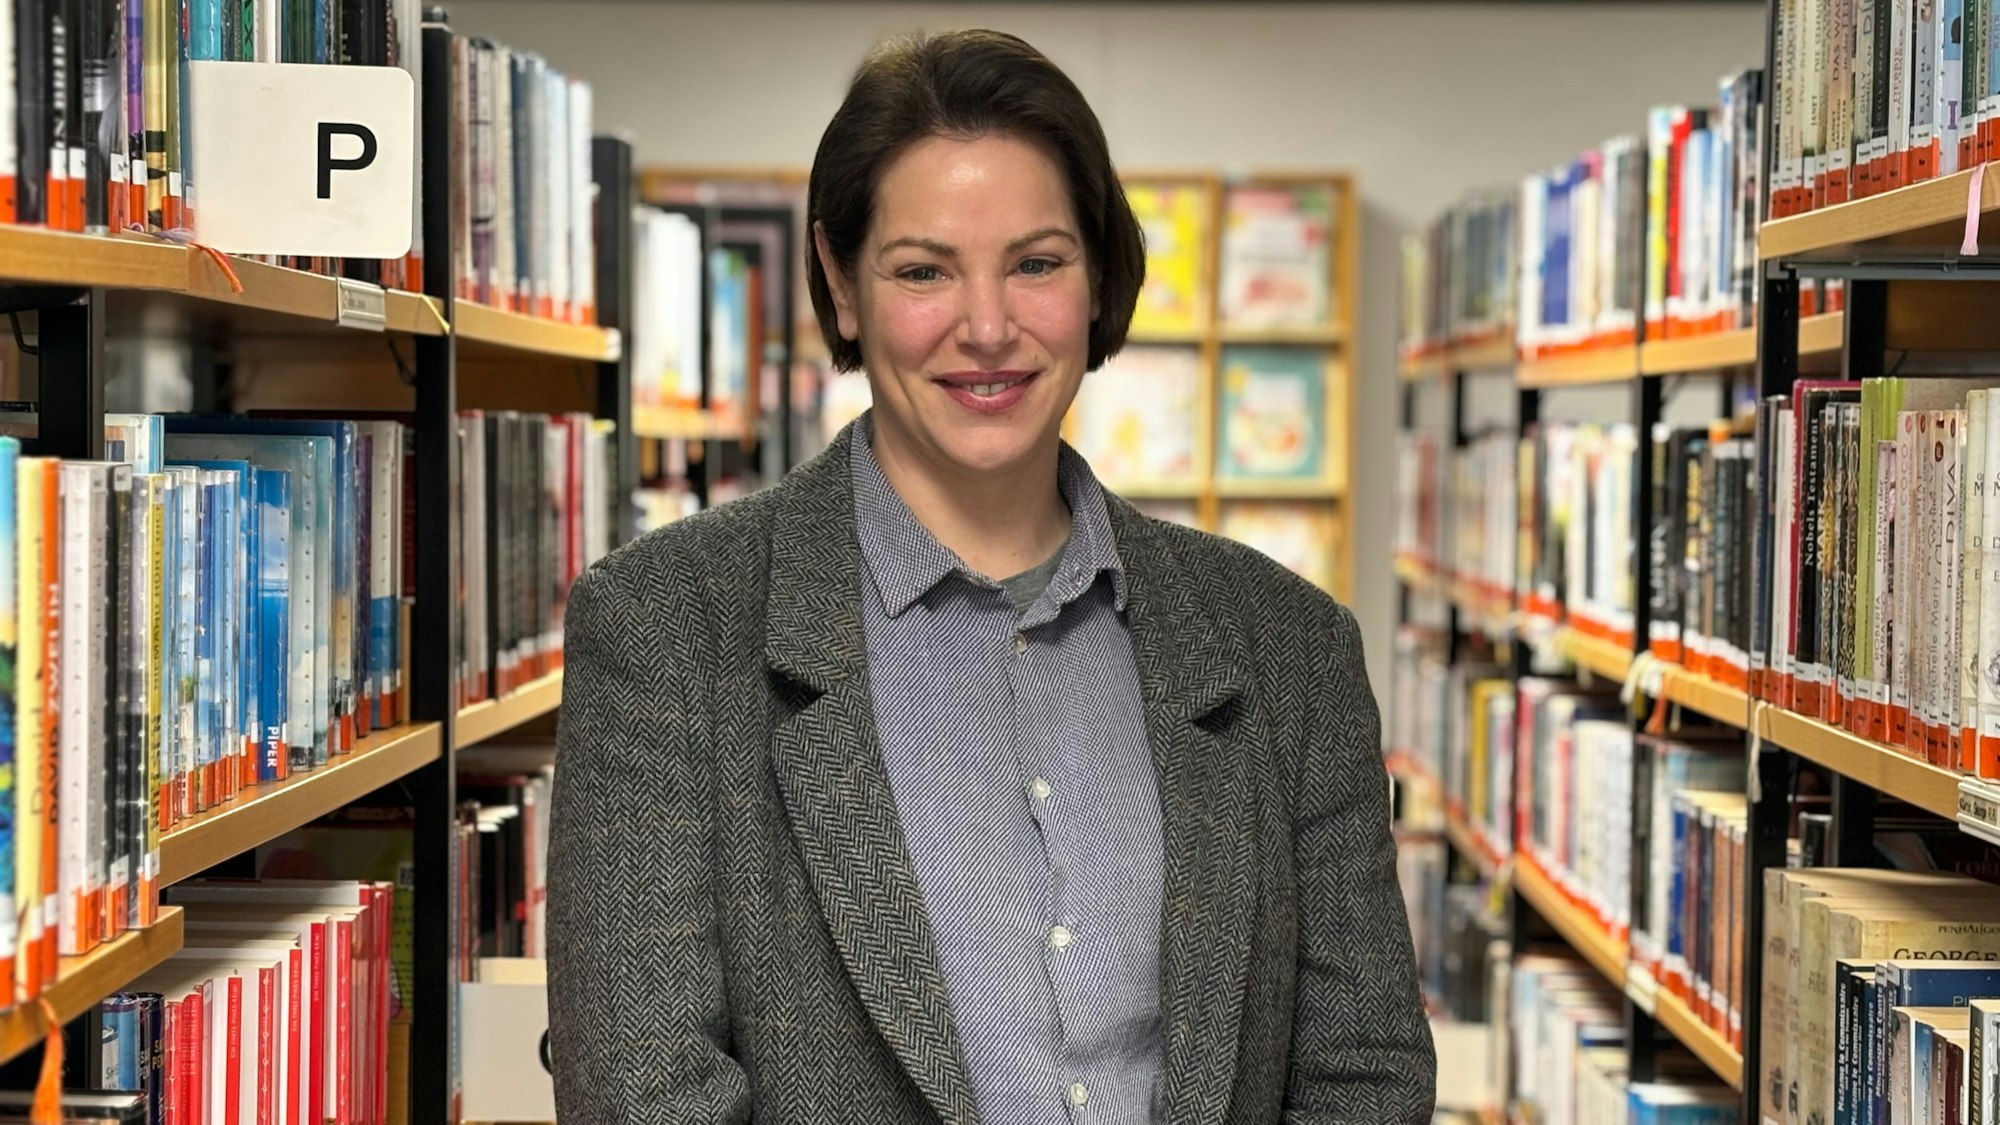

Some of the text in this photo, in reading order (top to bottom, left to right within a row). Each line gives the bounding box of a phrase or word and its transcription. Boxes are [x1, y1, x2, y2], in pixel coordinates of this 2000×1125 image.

[1860, 72, 1868, 115] GILLY
[317, 122, 377, 199] P
[1803, 417, 1818, 567] Nobels Testament
[1899, 444, 1908, 507] COCO
[1945, 461, 1957, 544] DIVA
[1873, 595, 1881, 661] ROBERTA
[1879, 591, 1887, 668] MARASCO
[1929, 576, 1941, 628] Marly
[1929, 635, 1940, 707] Michelle
[47, 725, 59, 825] DAVID
[267, 725, 280, 768] PIPER
[1838, 983, 1847, 1051] Commissaire
[1851, 996, 1859, 1066] Commissaire
[1876, 1027, 1882, 1040] le
[1838, 1052, 1845, 1065] le
[1851, 1067, 1858, 1079] le
[1867, 1074, 1873, 1086] le
